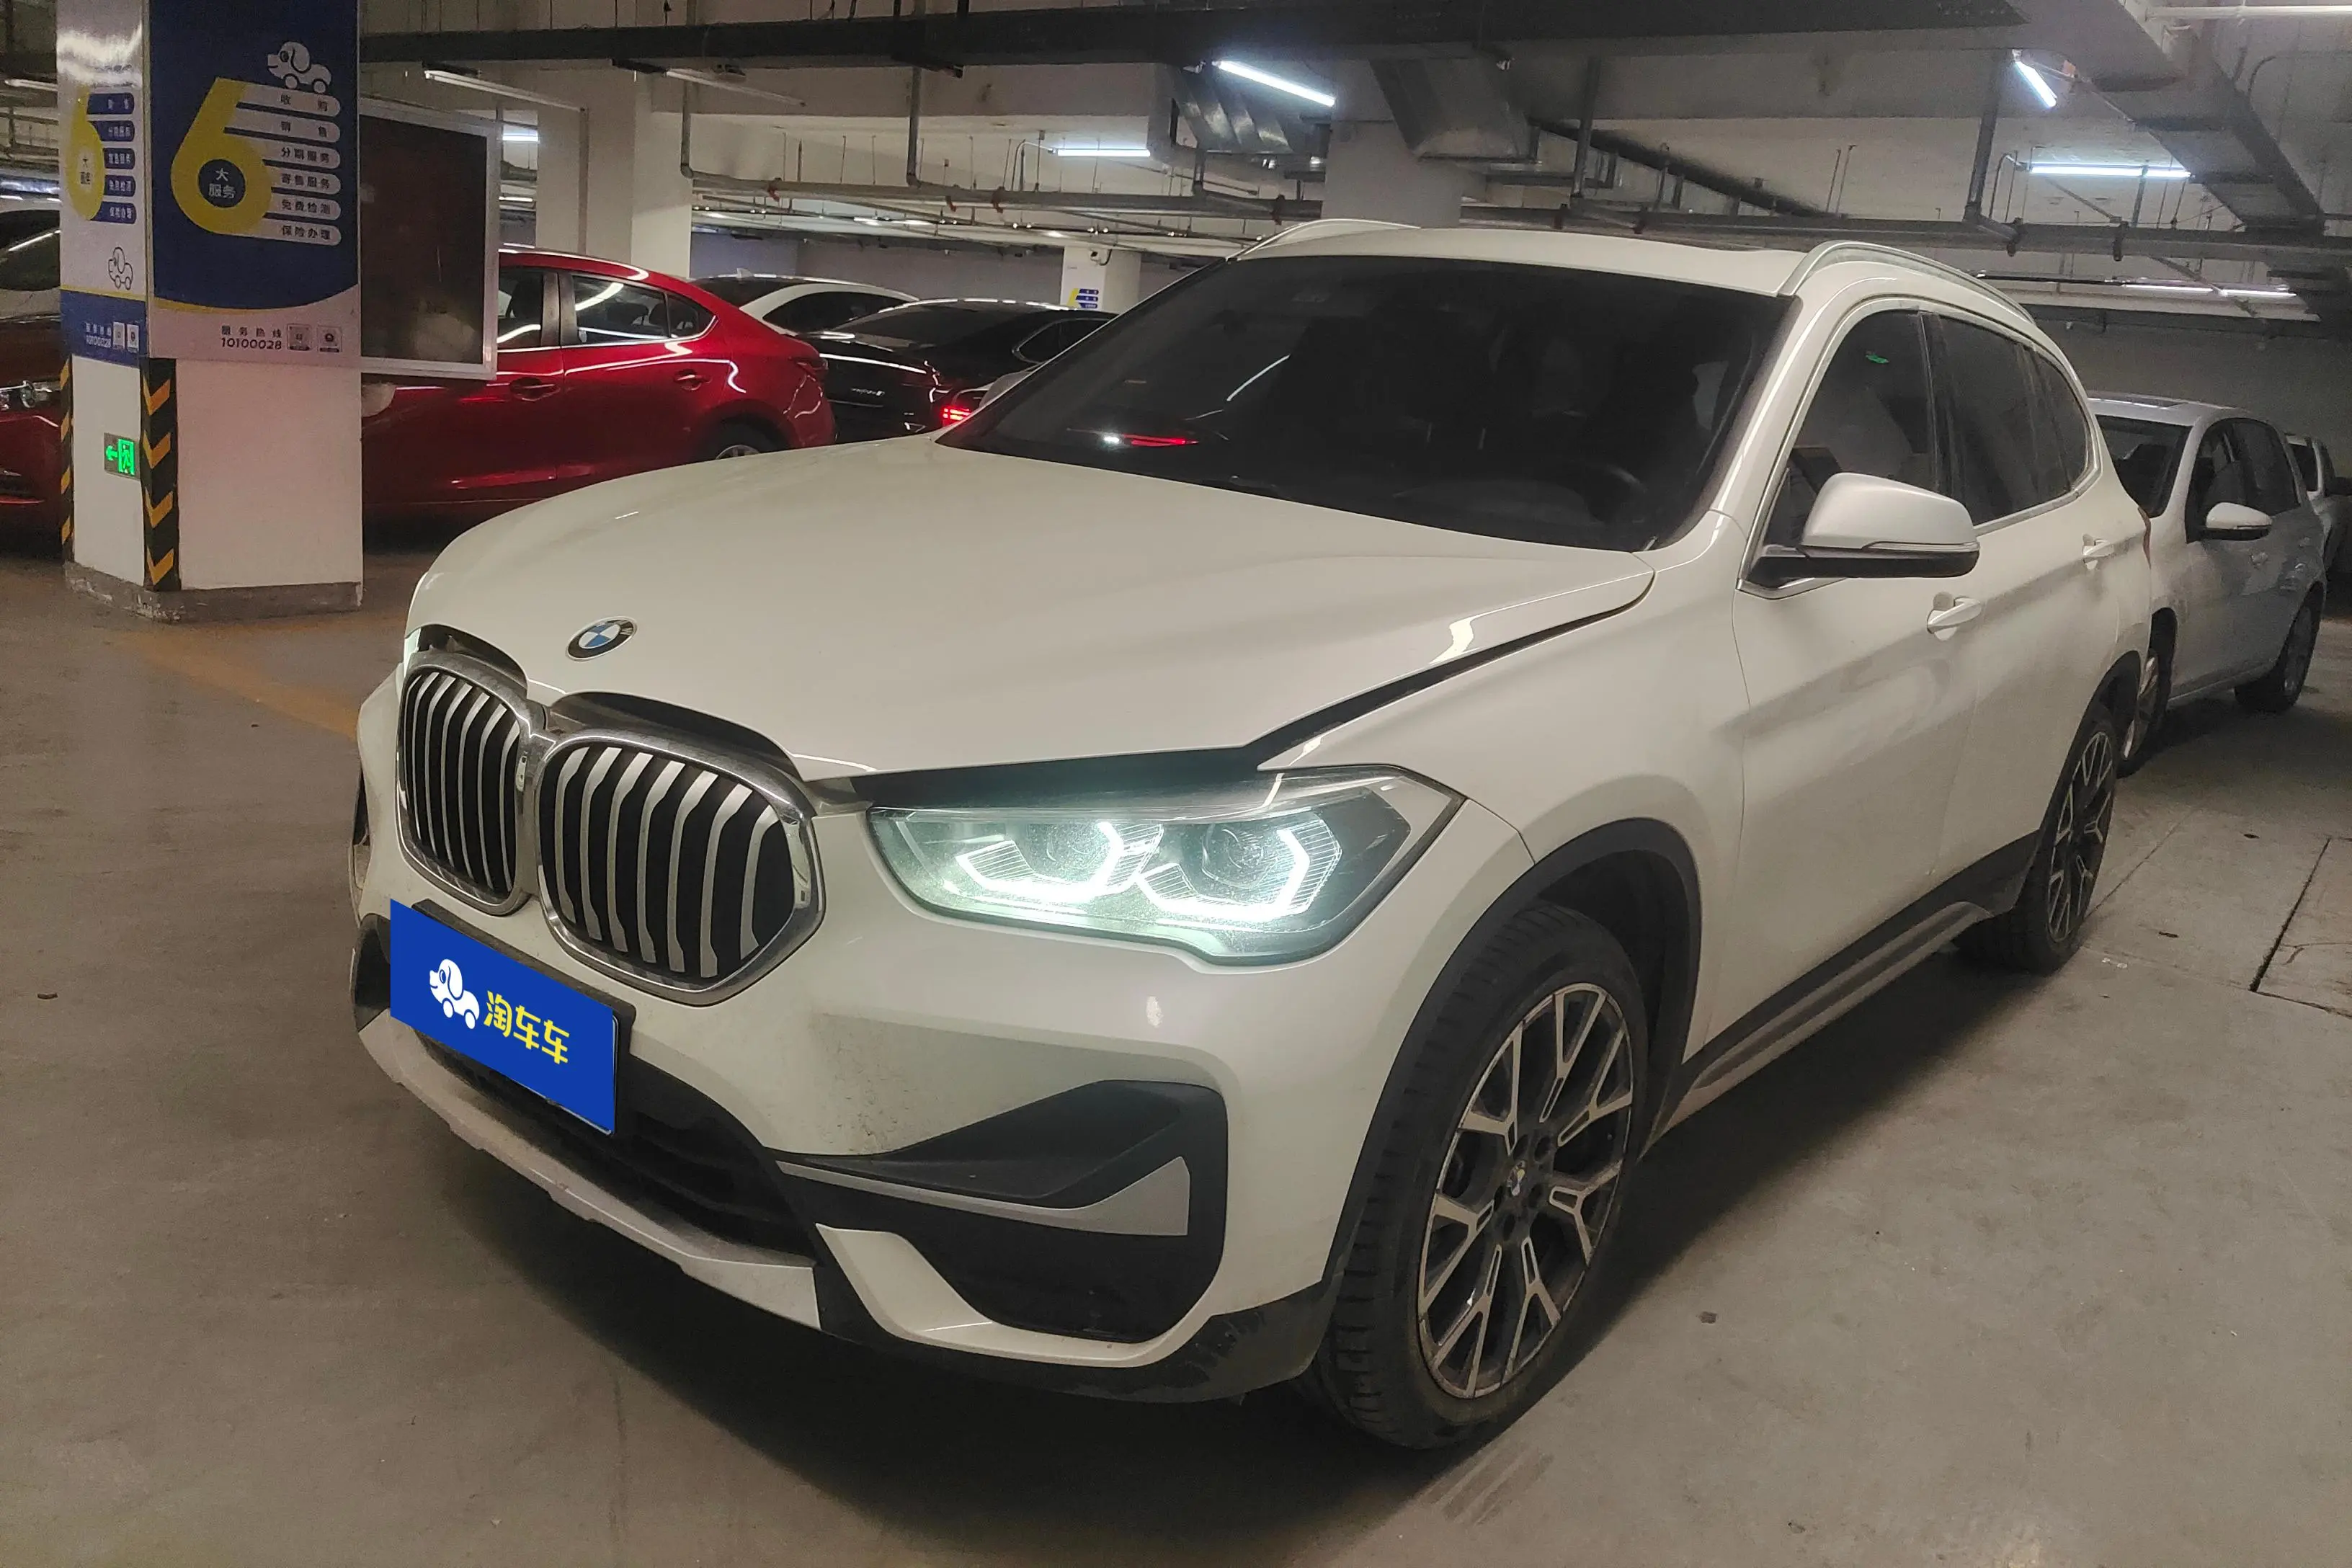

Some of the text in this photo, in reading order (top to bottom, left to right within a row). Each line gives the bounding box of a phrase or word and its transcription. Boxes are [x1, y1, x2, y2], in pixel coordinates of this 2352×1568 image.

[215, 167, 229, 182] 大
[208, 182, 236, 199] 服务
[282, 225, 331, 240] 保险办理
[220, 337, 282, 350] 10100028
